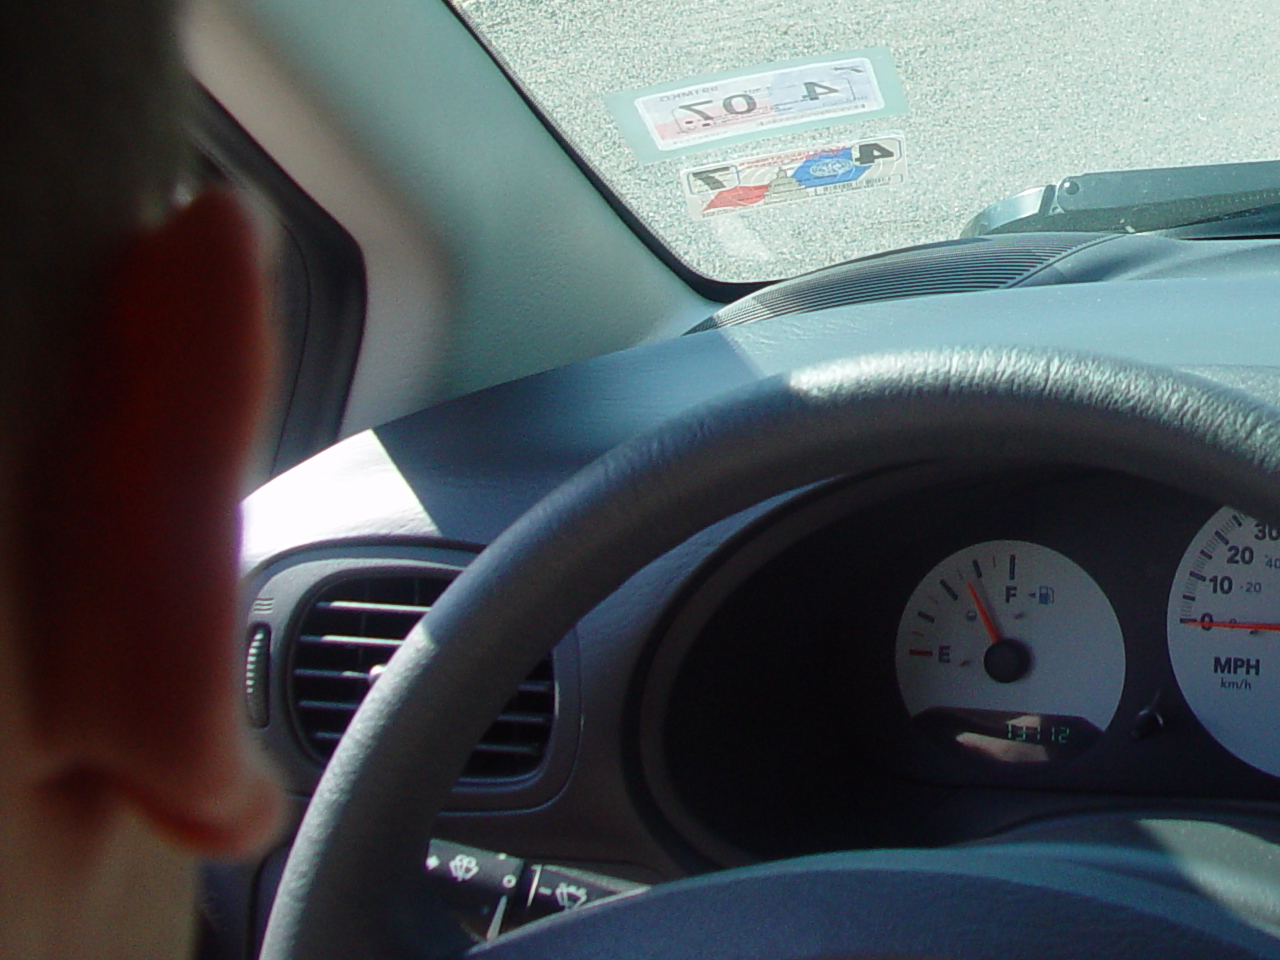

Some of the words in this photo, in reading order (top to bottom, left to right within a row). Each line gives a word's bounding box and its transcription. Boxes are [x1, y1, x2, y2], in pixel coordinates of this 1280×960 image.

[1254, 523, 1280, 541] 30
[1226, 546, 1254, 565] 20
[1209, 576, 1233, 594] 10
[1246, 582, 1262, 594] 20
[1005, 586, 1018, 603] F
[1200, 612, 1214, 632] 0
[938, 645, 951, 663] E
[1213, 656, 1260, 676] MPH
[1220, 678, 1252, 691] km/h
